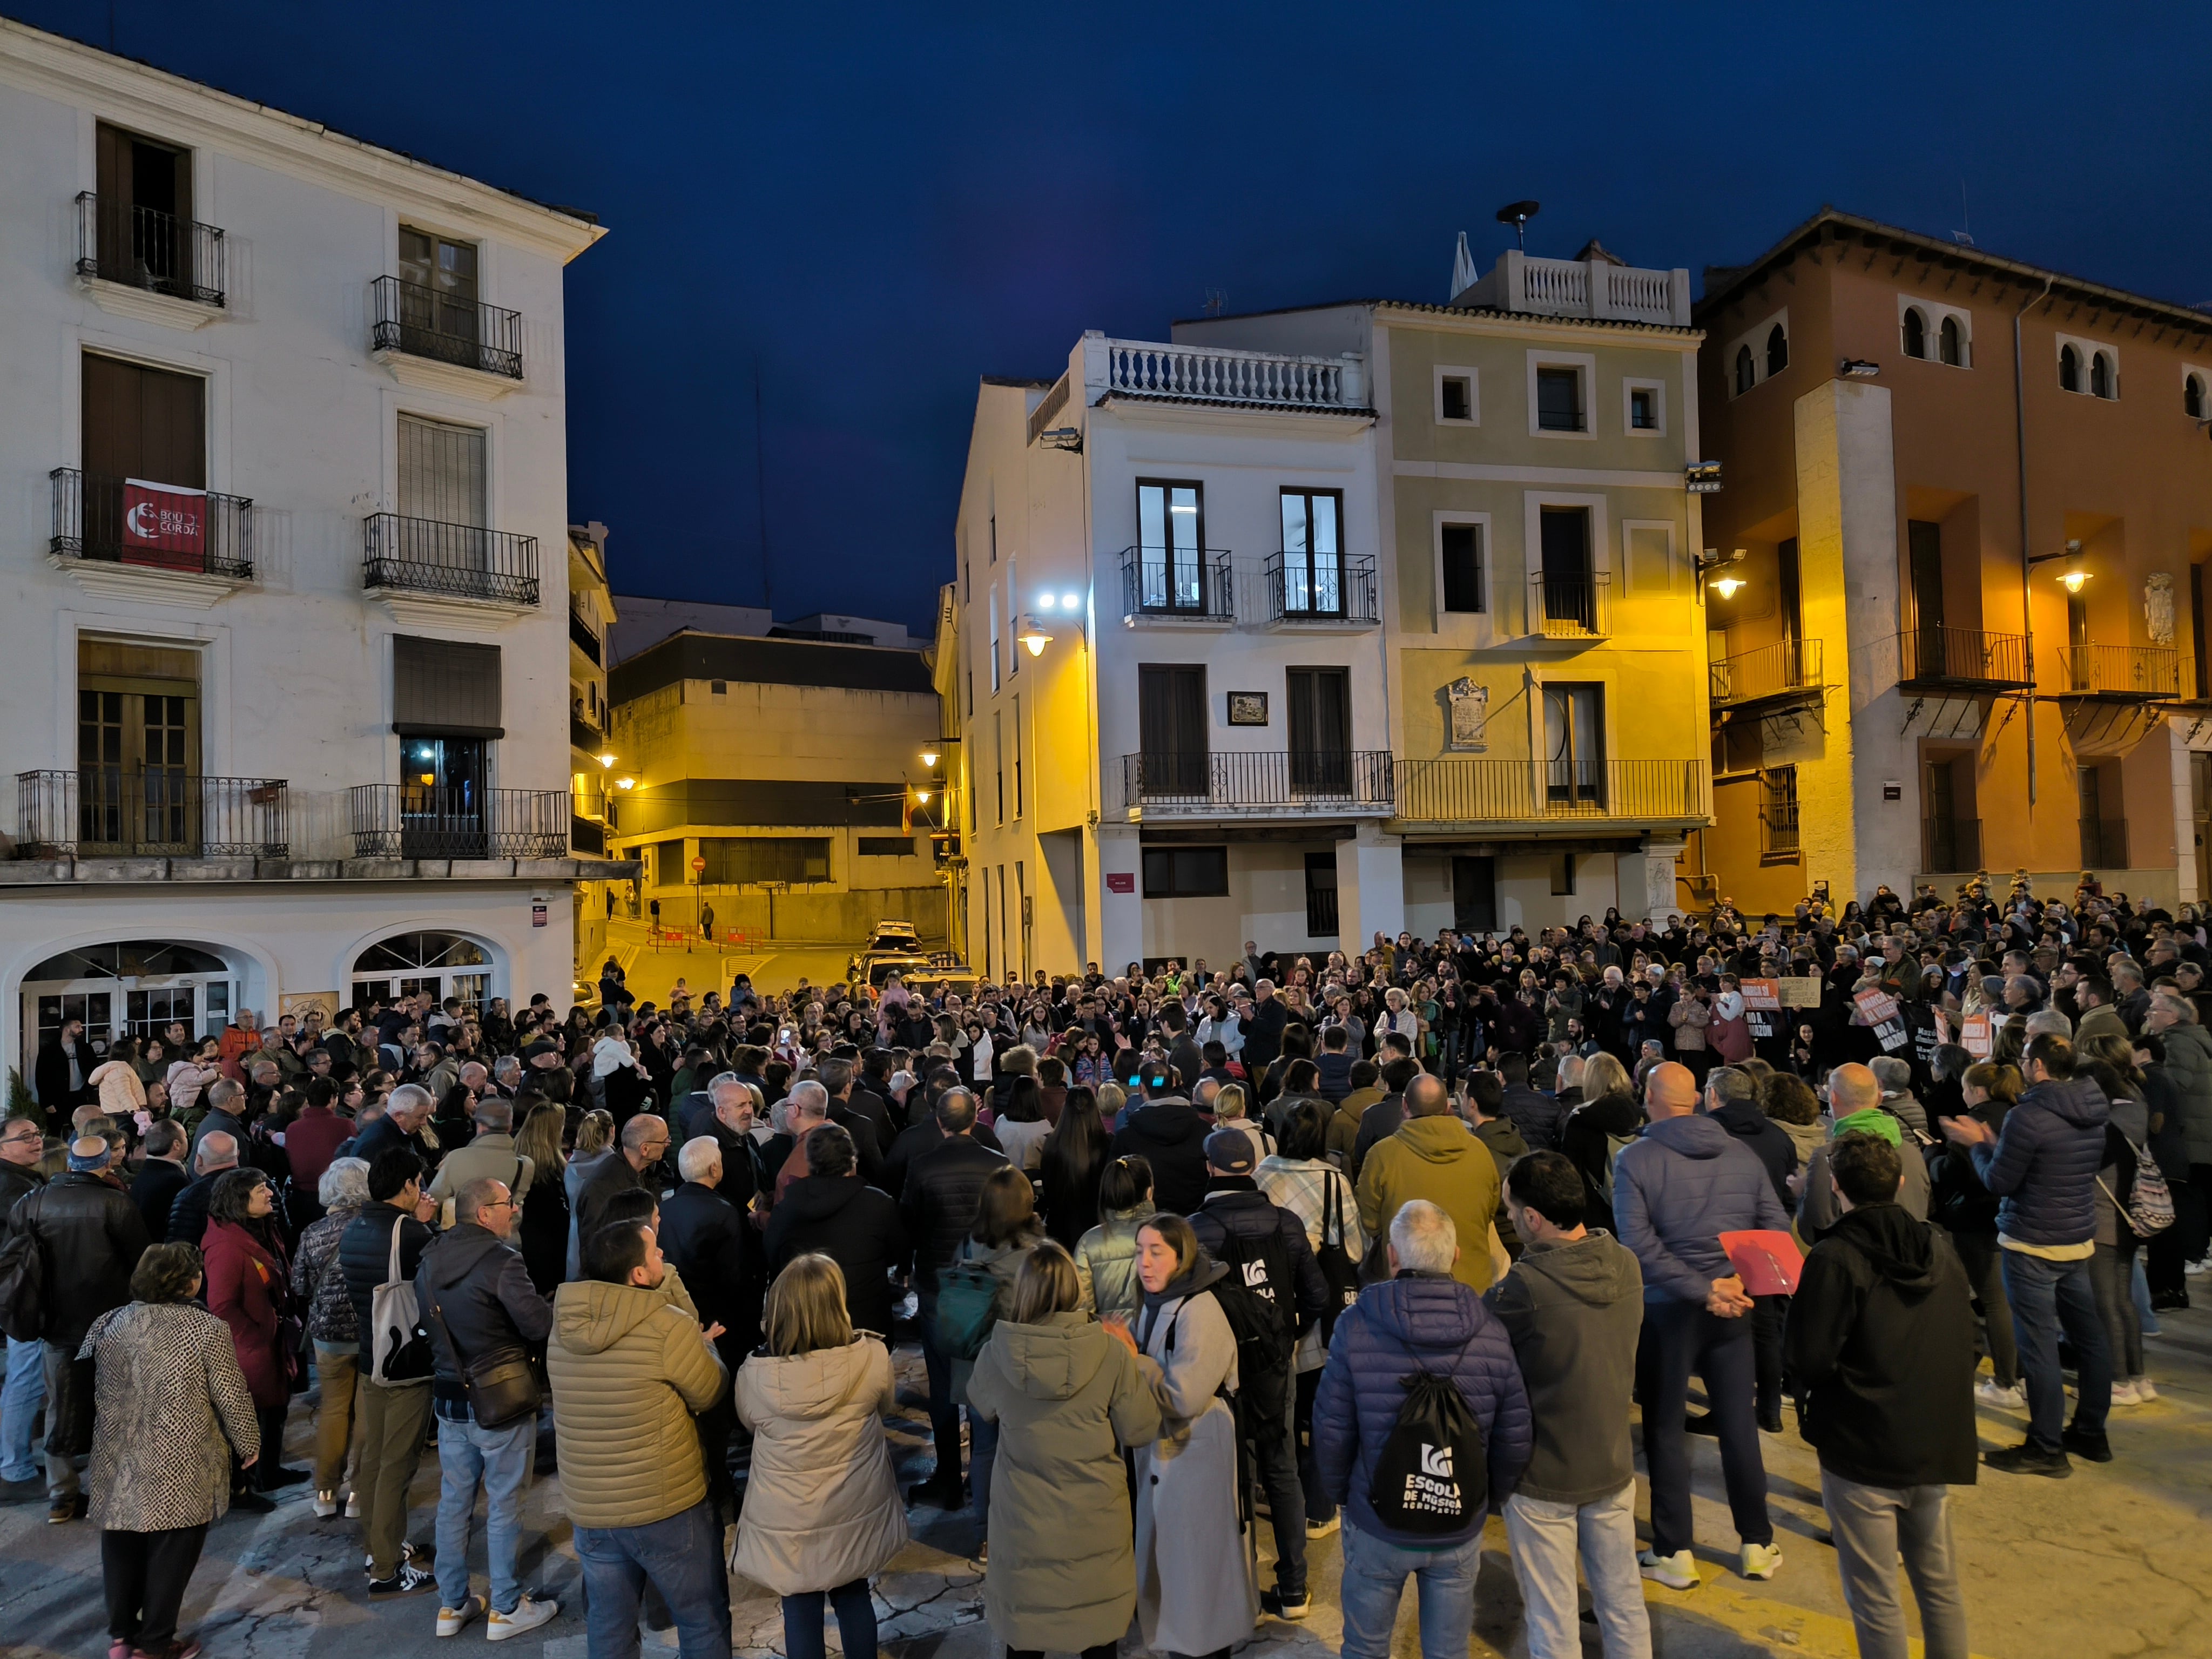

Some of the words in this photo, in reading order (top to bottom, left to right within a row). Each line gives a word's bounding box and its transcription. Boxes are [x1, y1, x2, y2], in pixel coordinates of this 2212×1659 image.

[160, 510, 183, 522] BOU
[160, 522, 198, 536] CORDA
[1745, 1012, 1756, 1023] NO
[1756, 1012, 1763, 1023] A
[1748, 1022, 1772, 1037] MAZÓN
[1873, 1024, 1888, 1039] NO
[1885, 1021, 1896, 1034] A
[1918, 1027, 1937, 1037] Mazó
[1405, 1474, 1461, 1499] ESCOLA
[1404, 1490, 1418, 1501] DE
